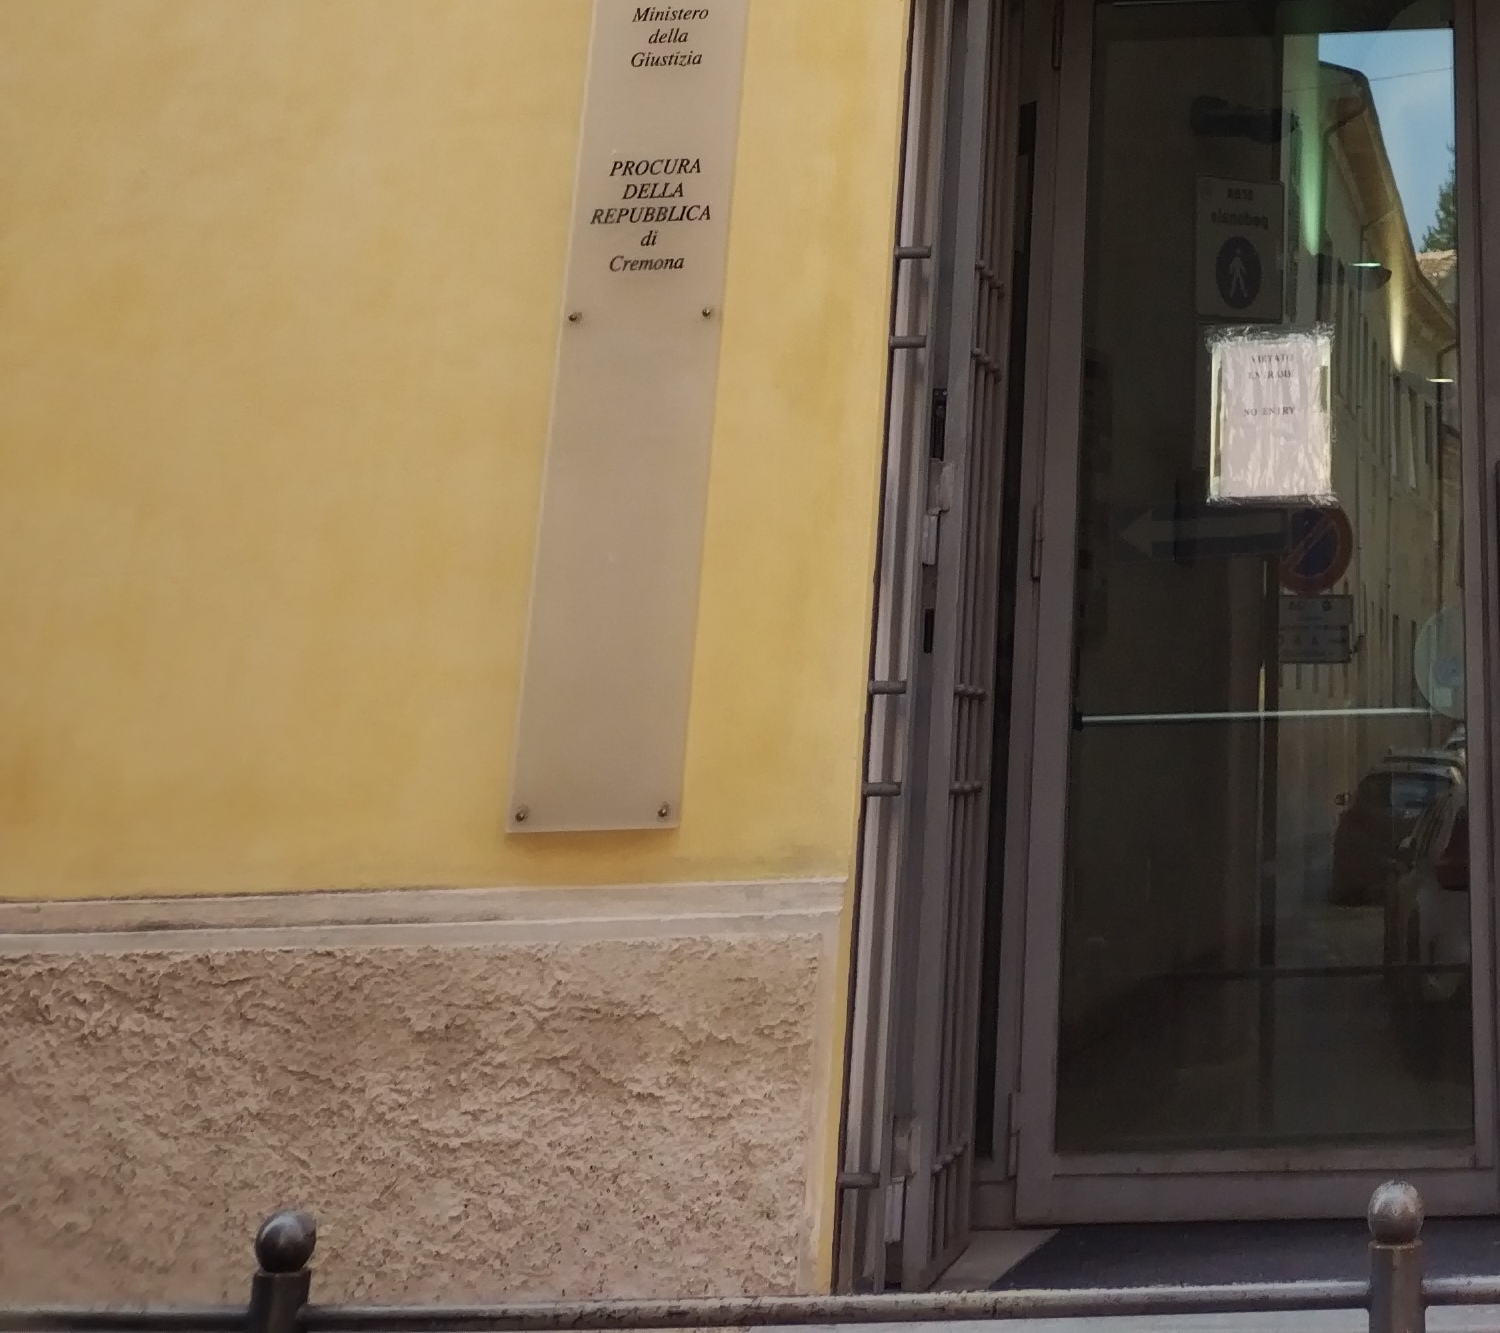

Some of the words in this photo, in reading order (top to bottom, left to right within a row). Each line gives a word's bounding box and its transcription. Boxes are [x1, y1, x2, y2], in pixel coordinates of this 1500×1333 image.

[631, 6, 709, 22] Ministero
[648, 27, 689, 44] della
[630, 50, 703, 68] Giustizia
[609, 158, 702, 177] PROCURA
[622, 182, 684, 200] DELLA
[590, 205, 711, 225] REPUBBLICA
[640, 230, 659, 247] di
[609, 255, 685, 273] Cremona
